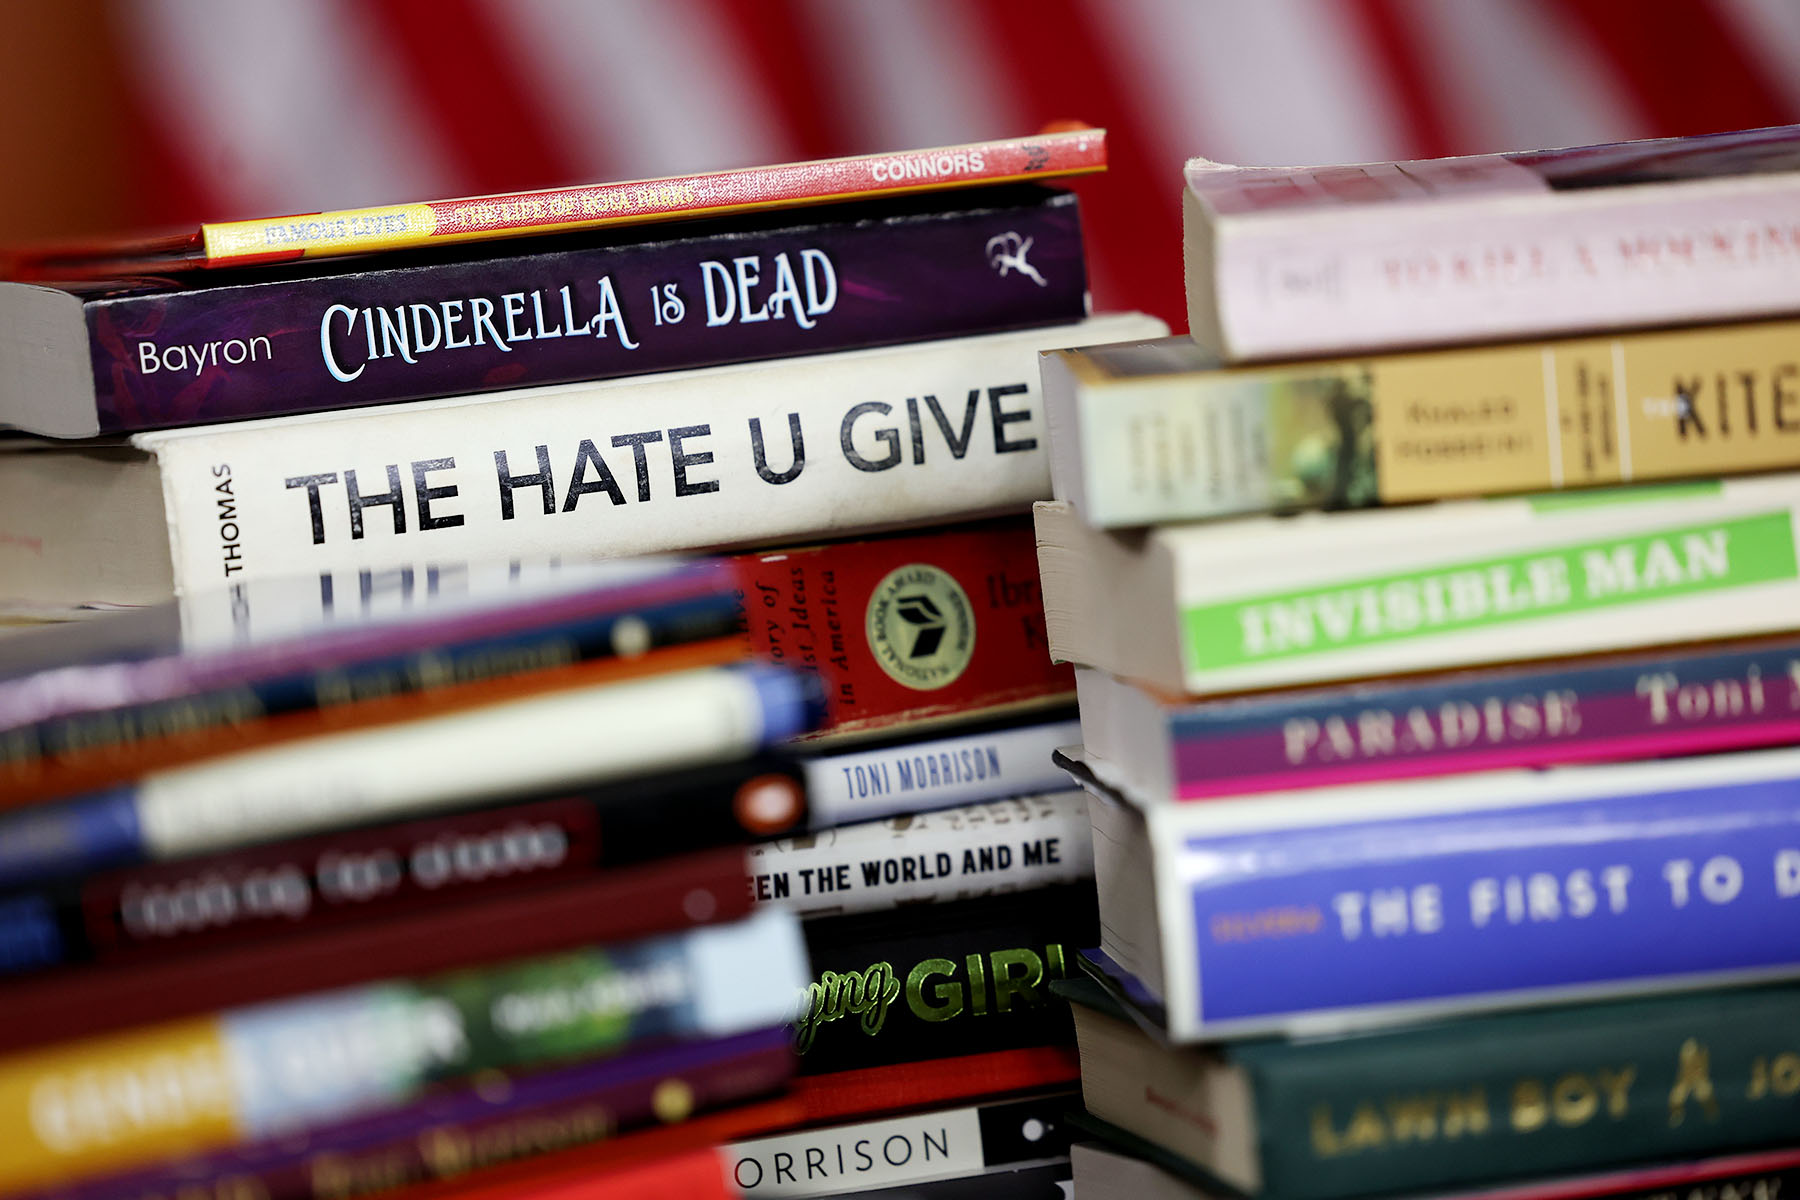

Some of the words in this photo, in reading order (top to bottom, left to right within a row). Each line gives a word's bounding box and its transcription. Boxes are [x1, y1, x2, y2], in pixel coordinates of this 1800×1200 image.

[265, 219, 345, 245] FAMOUS
[349, 212, 407, 237] LIVES
[872, 152, 985, 182] CONNORS
[139, 333, 272, 376] Bayron
[320, 275, 640, 382] CINDERELLA
[650, 282, 686, 326] IS
[700, 248, 837, 330] DEAD
[1671, 364, 1800, 444] KITE
[285, 456, 465, 545] THE
[493, 423, 720, 520] HATE
[748, 412, 806, 486] U
[839, 383, 1038, 473] GIVE
[212, 463, 244, 578] THOMAS
[820, 570, 850, 671] America
[1237, 554, 1573, 657] INVISIBLE
[1583, 528, 1731, 598] MAN
[1282, 688, 1583, 765] PARADISE
[1635, 663, 1765, 725] Toni
[842, 761, 892, 800] TONI
[896, 744, 1002, 793] MORRISON
[799, 863, 853, 896] THE
[860, 852, 953, 888] WORLD
[961, 844, 1013, 876] AND
[1022, 837, 1062, 868] ME
[1332, 882, 1445, 941] THE
[1468, 864, 1633, 929] FIRST
[1661, 853, 1745, 910] TO
[1510, 1062, 1638, 1134] BOY
[734, 1127, 950, 1190] ORRISON
